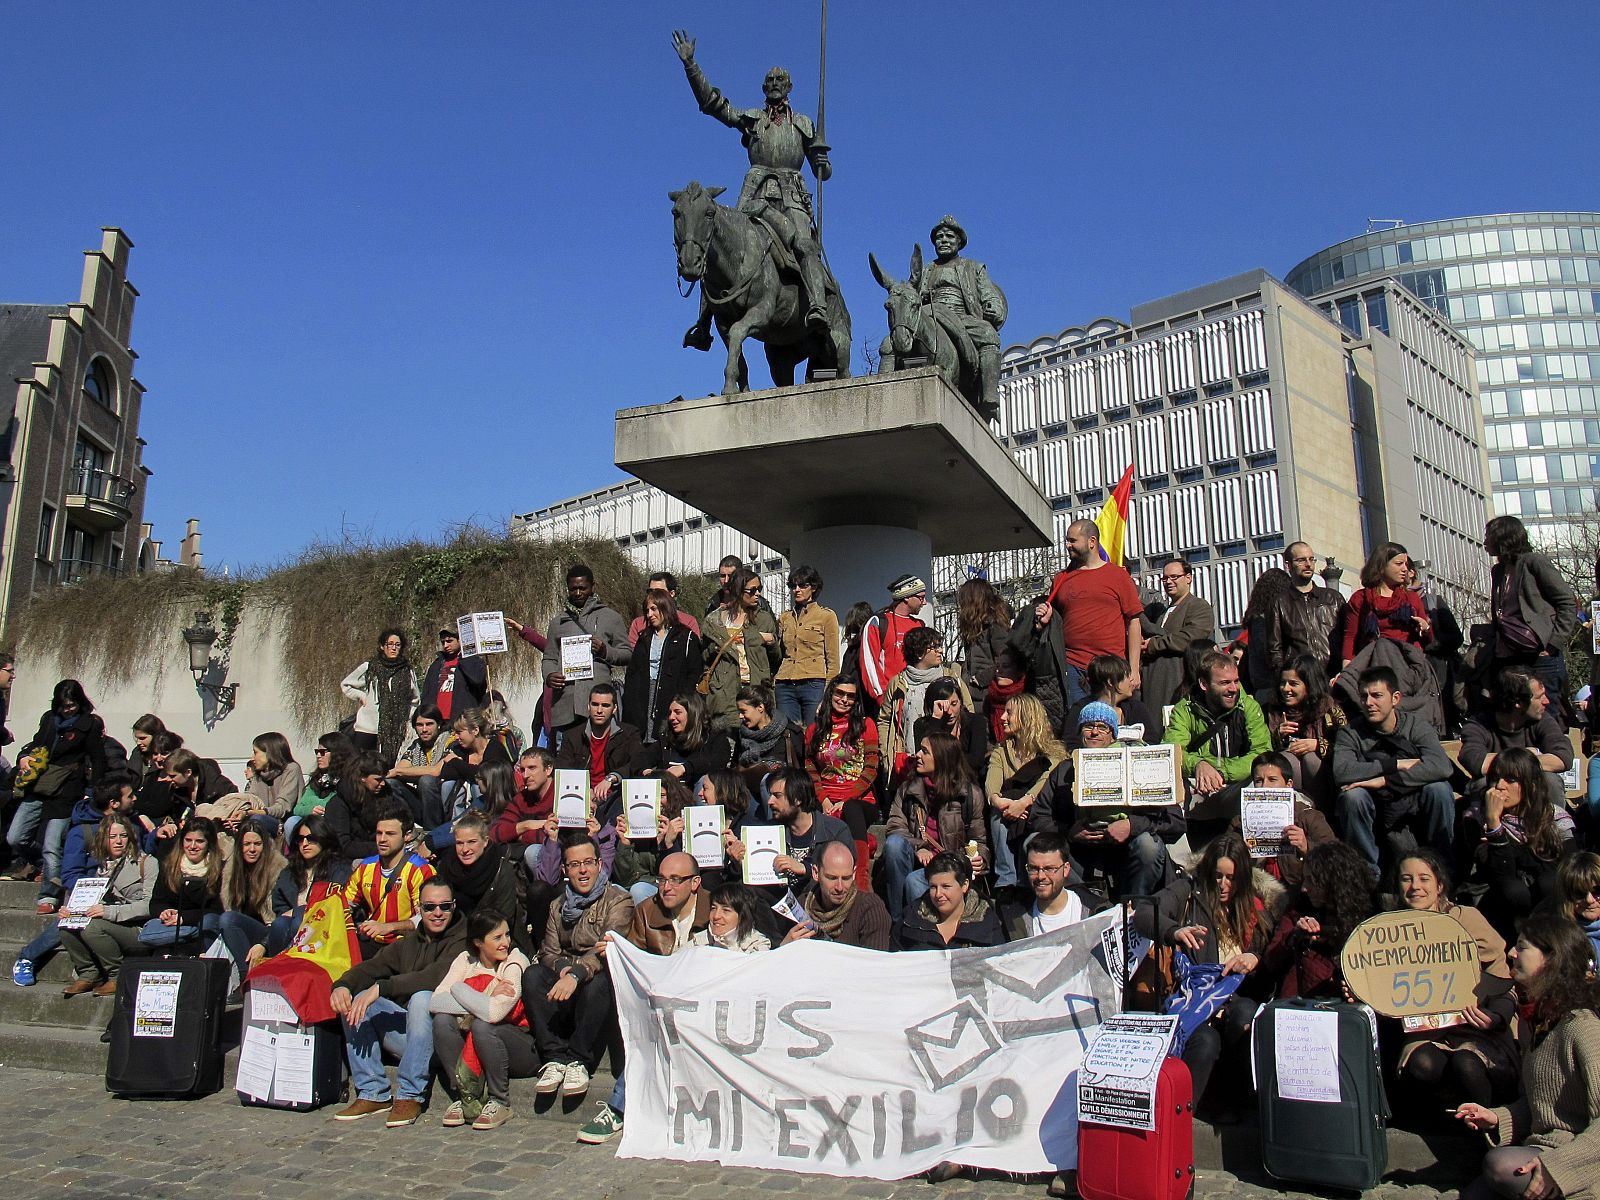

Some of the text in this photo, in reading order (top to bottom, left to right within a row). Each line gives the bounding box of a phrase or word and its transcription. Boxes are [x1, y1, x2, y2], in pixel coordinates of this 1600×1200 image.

[1363, 921, 1426, 944] YOUTH
[1347, 934, 1474, 970] UNEMPLOYMENT
[647, 994, 834, 1059] TUS
[1081, 1104, 1100, 1112] QU'ILS
[1094, 1094, 1136, 1106] Manifestation
[673, 1078, 1028, 1167] MI EXILIO
